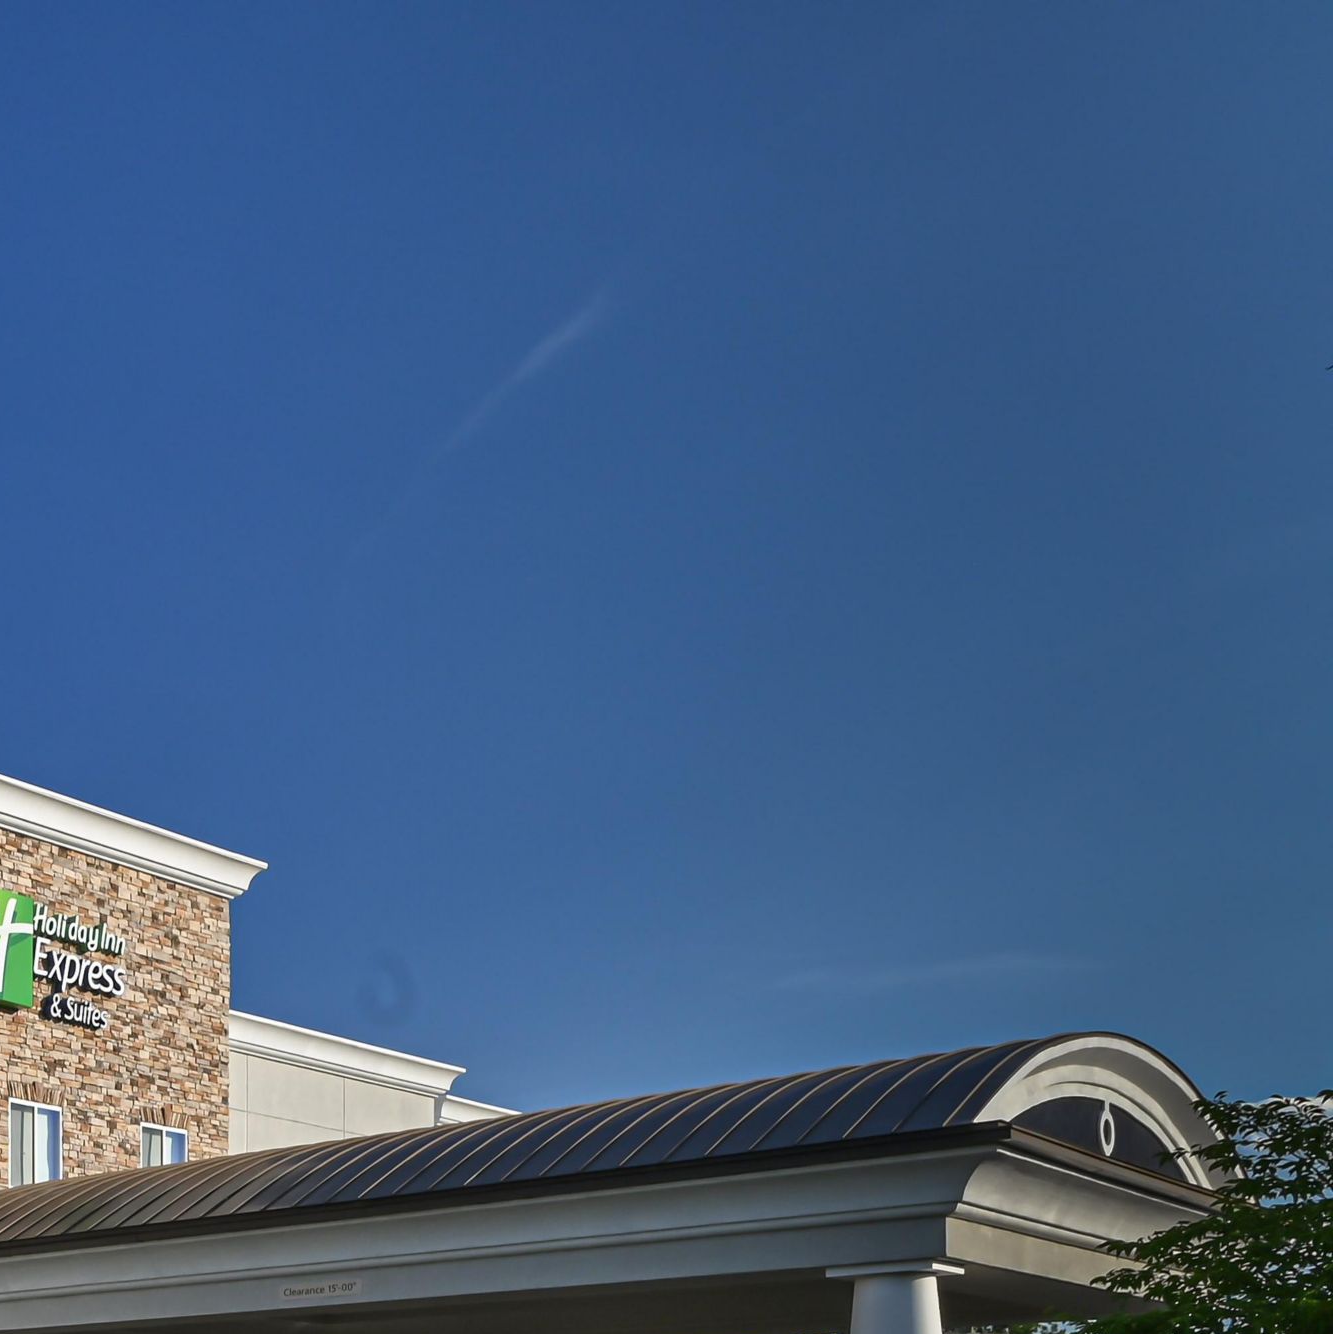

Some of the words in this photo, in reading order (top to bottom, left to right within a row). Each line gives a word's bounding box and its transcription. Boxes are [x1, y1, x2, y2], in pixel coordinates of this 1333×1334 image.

[33, 902, 100, 952] Holiday
[101, 922, 126, 956] Inn
[33, 936, 126, 996] Express
[50, 993, 62, 1018] &
[64, 996, 110, 1029] Suites
[283, 1286, 326, 1297] Clearance
